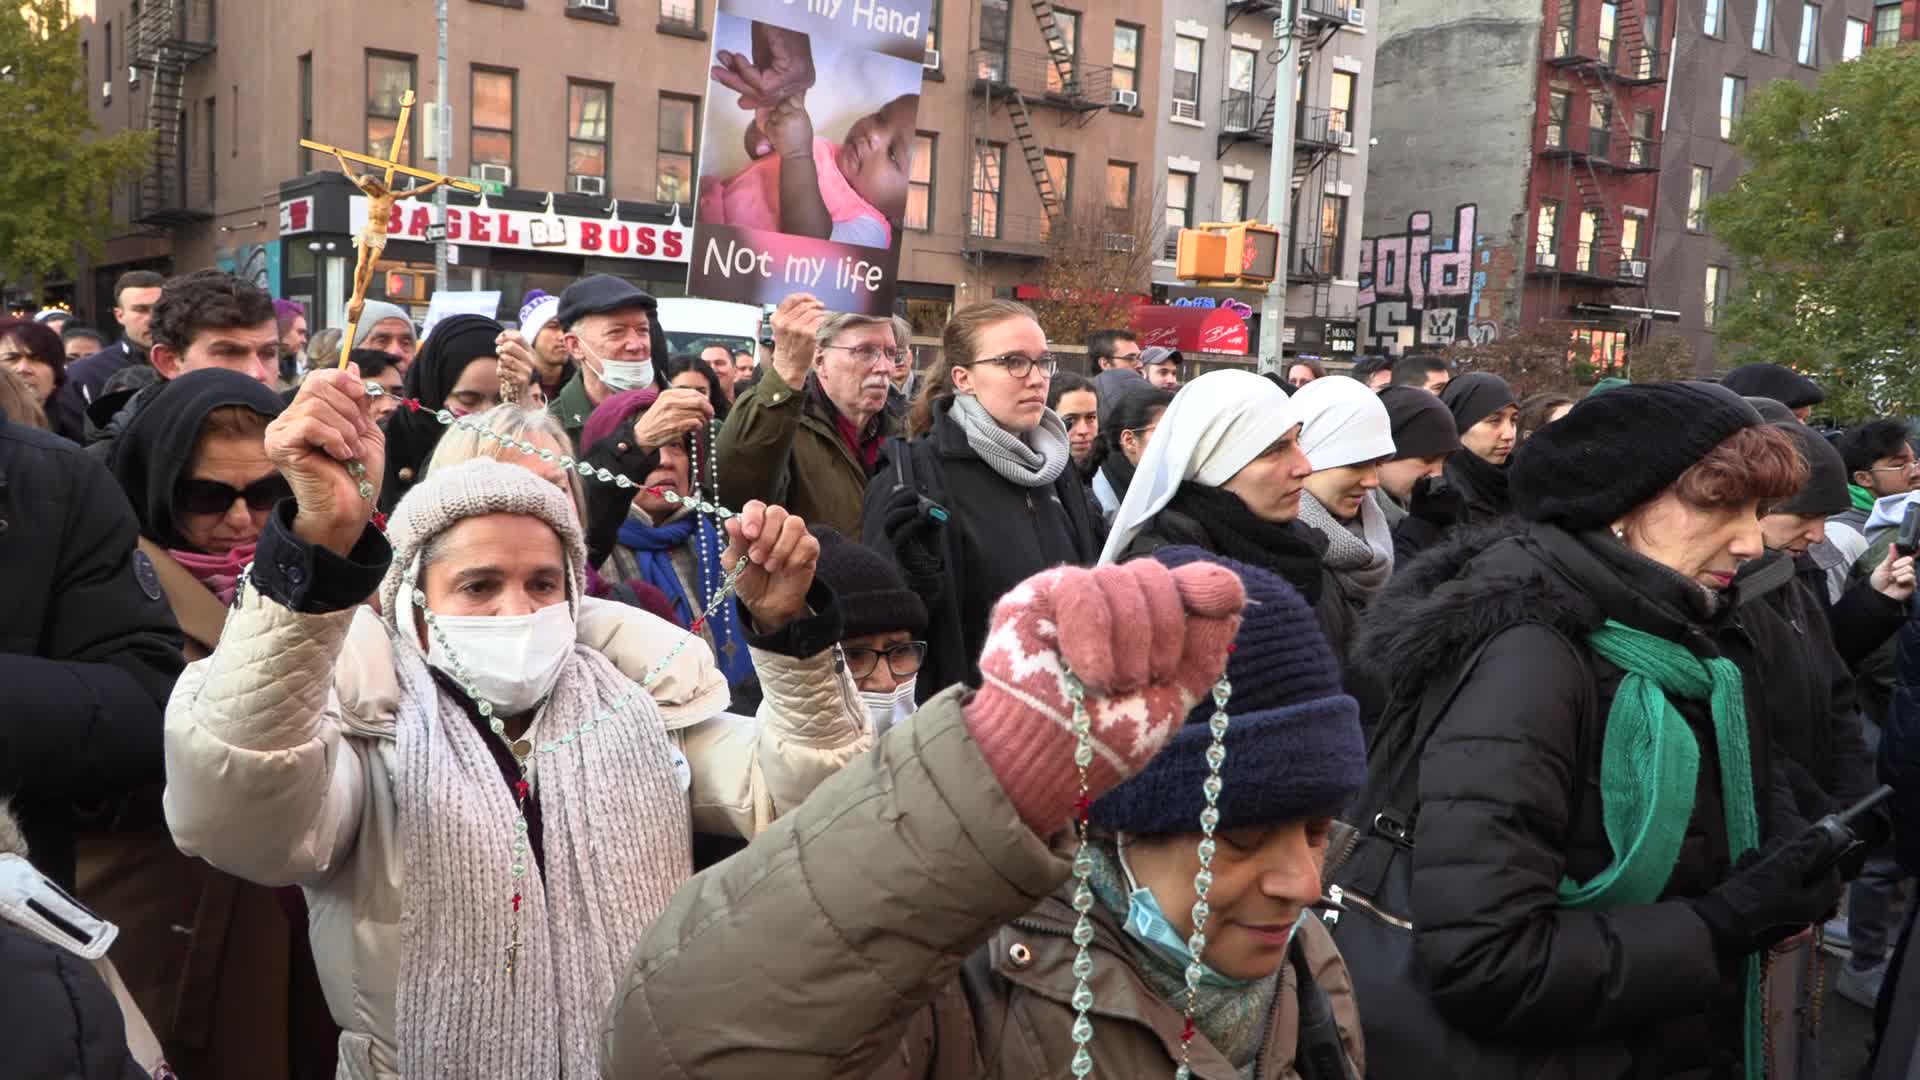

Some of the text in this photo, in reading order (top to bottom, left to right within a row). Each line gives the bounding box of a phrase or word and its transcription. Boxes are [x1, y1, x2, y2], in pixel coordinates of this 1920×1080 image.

[852, 0, 921, 39] Hand
[388, 205, 519, 244] BAGEL
[580, 222, 683, 258] BOSS
[703, 237, 883, 294] Not my life
[1332, 340, 1355, 351] BAR
